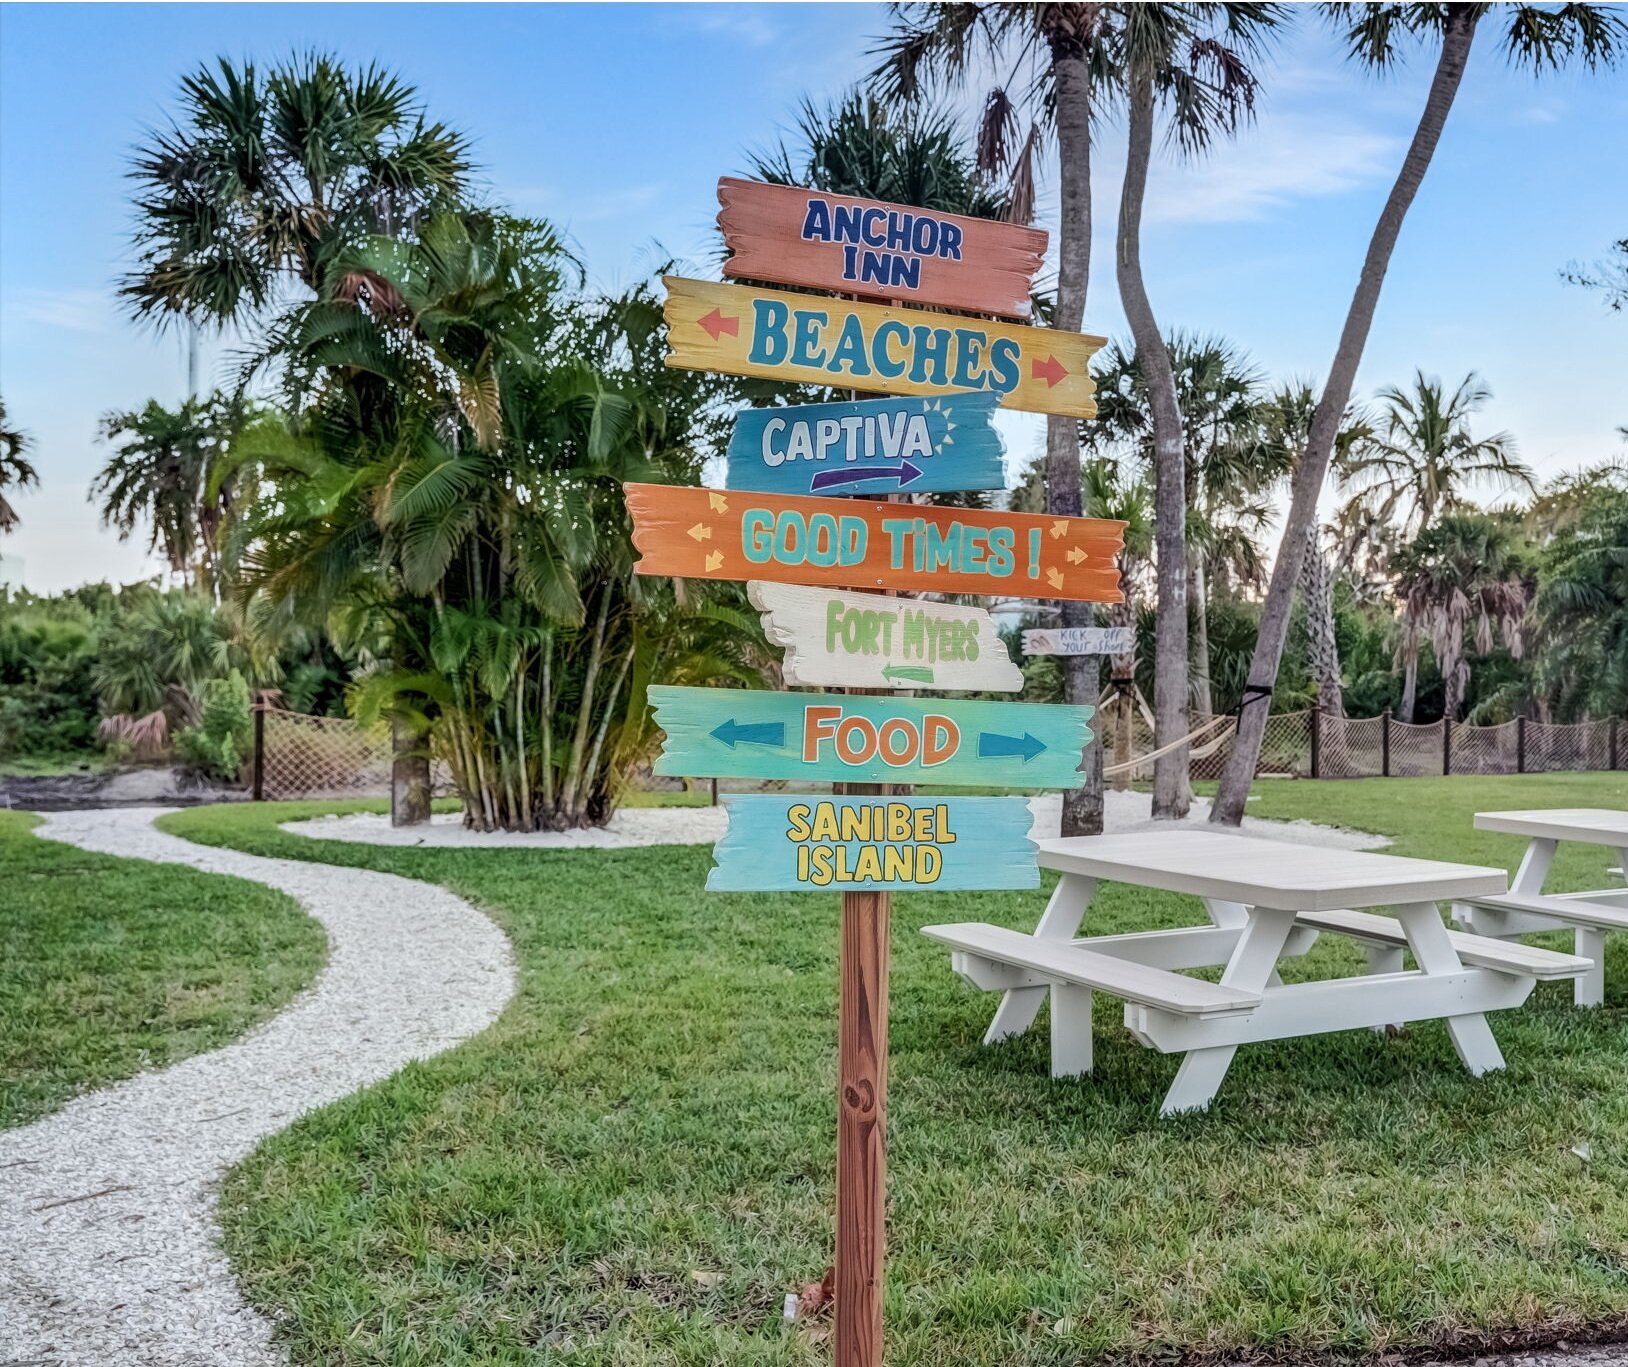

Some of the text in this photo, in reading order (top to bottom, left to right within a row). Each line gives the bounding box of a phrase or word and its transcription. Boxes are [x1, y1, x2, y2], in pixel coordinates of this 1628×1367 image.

[801, 199, 963, 262] ANCHOR
[842, 244, 922, 290] INN
[747, 298, 1022, 396] BEACHES
[761, 411, 934, 468] CAPTIVA
[741, 508, 869, 567] GOOD
[826, 600, 980, 664] FORT MYERS
[1060, 630, 1087, 640] KICK
[802, 705, 960, 768] FOOD
[786, 801, 957, 844] SANIBEL
[797, 845, 943, 886] ISLAND
